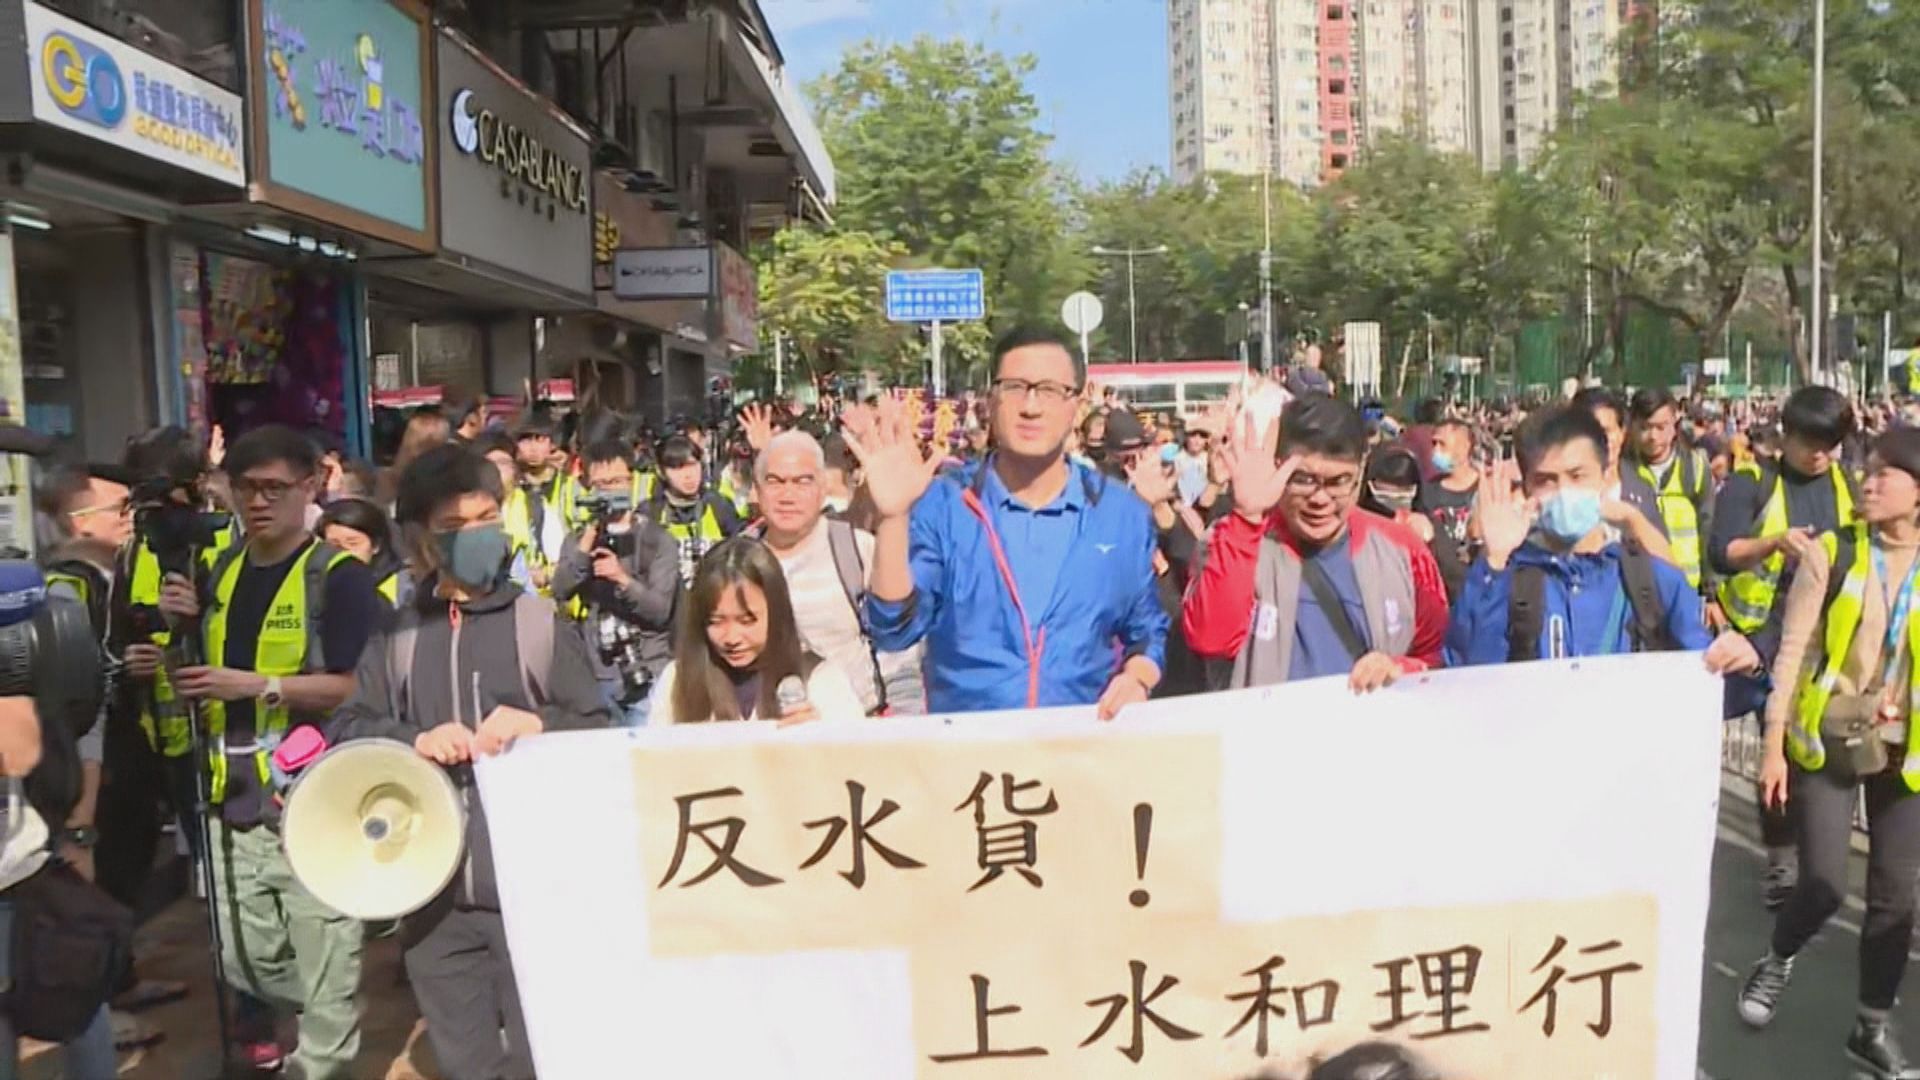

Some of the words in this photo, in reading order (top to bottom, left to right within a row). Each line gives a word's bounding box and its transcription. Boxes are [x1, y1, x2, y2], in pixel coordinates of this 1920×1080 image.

[478, 109, 589, 213] CASABLANCA
[267, 618, 301, 630] PRESS
[928, 935, 1643, 1064] 上水和理行
